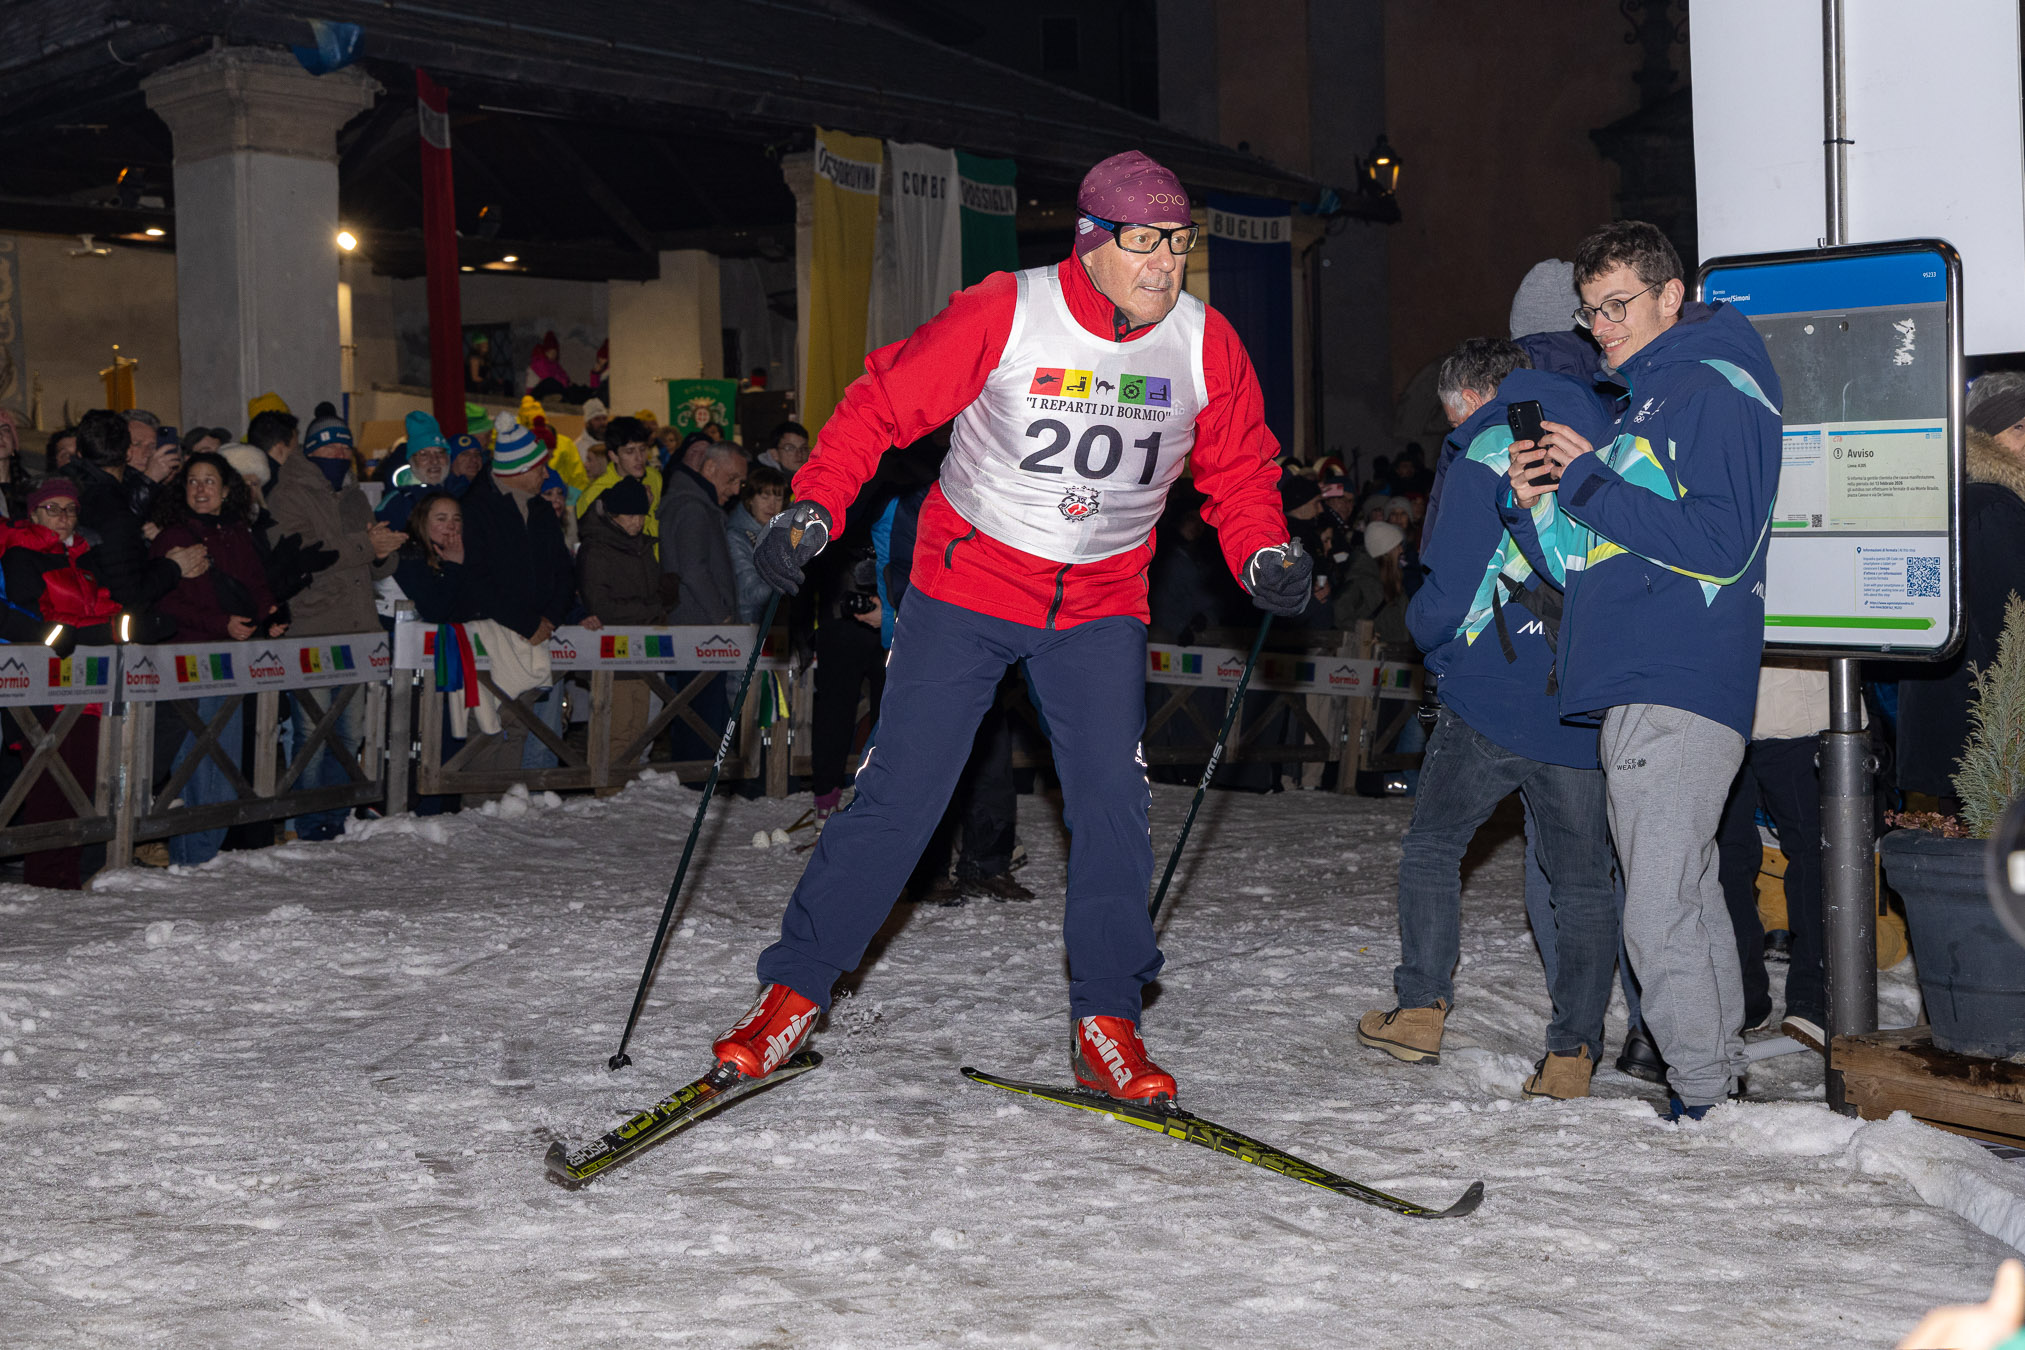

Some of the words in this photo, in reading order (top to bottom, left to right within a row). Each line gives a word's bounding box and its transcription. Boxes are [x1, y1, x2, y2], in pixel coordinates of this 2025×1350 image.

[1214, 213, 1279, 240] BUGLIO
[1040, 398, 1098, 415] REPARTI
[1100, 404, 1114, 416] DI
[1116, 406, 1171, 423] BORMIO"
[1019, 418, 1163, 485] 201
[1847, 448, 1874, 458] Avviso
[551, 645, 577, 659] mio
[695, 645, 742, 658] bormio
[126, 667, 161, 685] bormio
[248, 660, 286, 678] bormio
[0, 672, 30, 689] ormio
[1329, 673, 1360, 685] bormio
[713, 717, 736, 772] SWIX
[1199, 741, 1223, 793] SWIX
[566, 1139, 609, 1167] FISCHER
